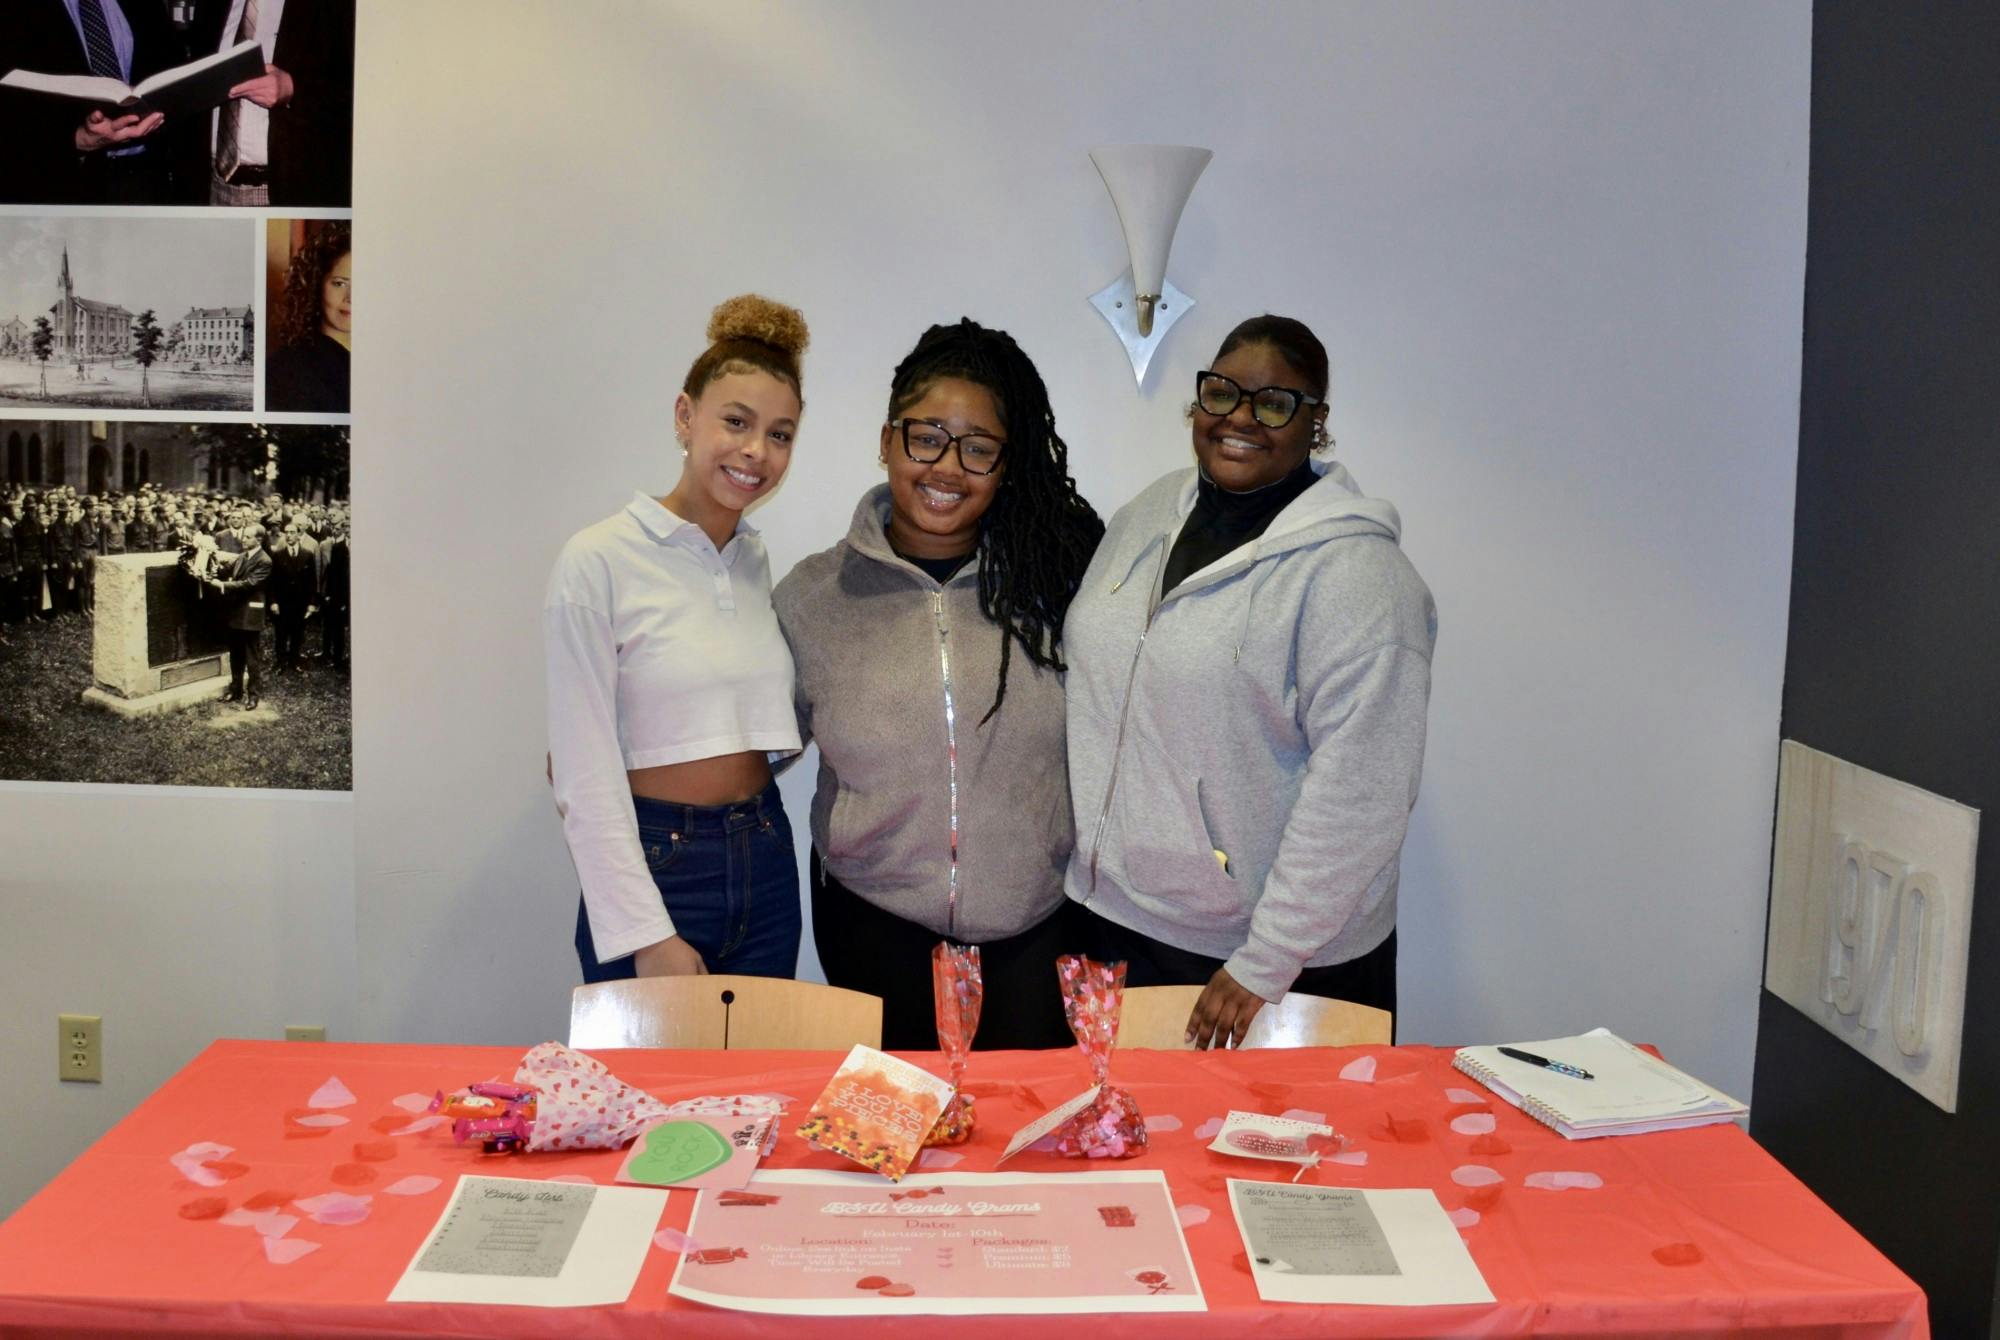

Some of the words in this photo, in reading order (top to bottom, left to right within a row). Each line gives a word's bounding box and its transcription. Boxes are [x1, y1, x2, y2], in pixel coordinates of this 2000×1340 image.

[838, 1088, 889, 1115] YOU
[892, 1113, 923, 1132] TO
[844, 1081, 859, 1092] I
[860, 1087, 924, 1122] LOVE
[830, 1096, 918, 1142] PIECES
[647, 1135, 677, 1165] YOU
[670, 1134, 705, 1174] ROCK
[483, 1188, 530, 1202] Candy
[820, 1202, 888, 1215] BSU
[892, 1202, 961, 1216] Candy
[968, 1202, 1041, 1216] Grams
[862, 1229, 938, 1240] February
[905, 1219, 956, 1229] Date:
[800, 1237, 874, 1245] Location:
